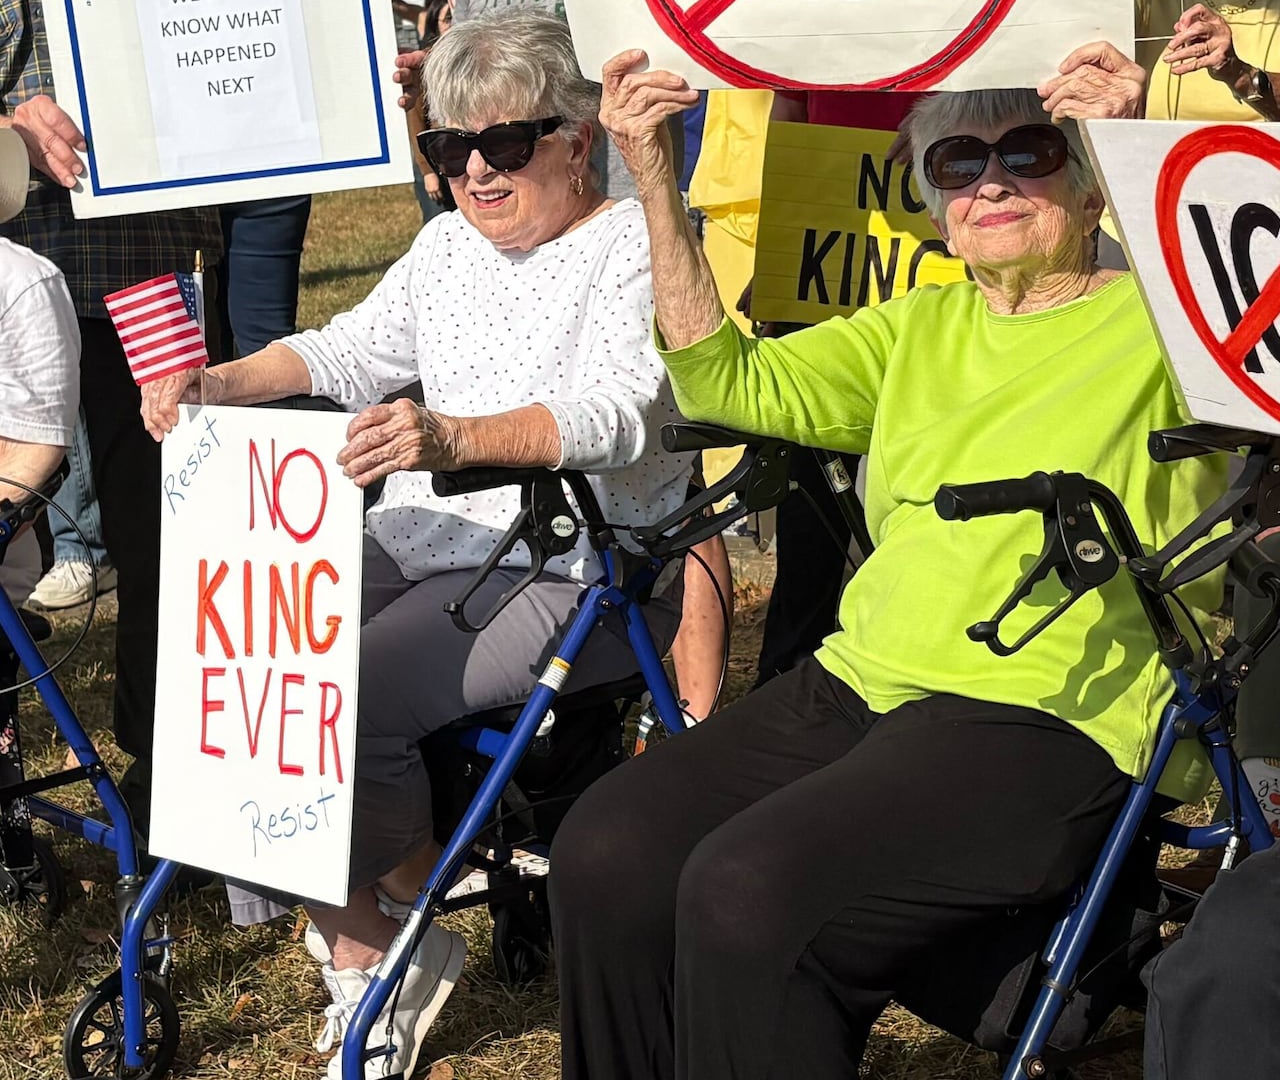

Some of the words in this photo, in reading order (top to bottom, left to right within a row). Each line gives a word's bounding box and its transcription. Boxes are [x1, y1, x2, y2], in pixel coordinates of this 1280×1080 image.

[161, 16, 220, 38] KNOW
[225, 8, 283, 29] WHAT
[176, 41, 277, 69] HAPPENED
[207, 75, 255, 97] NEXT
[164, 415, 223, 515] Resist
[249, 437, 328, 544] NO
[196, 558, 343, 660] KING
[200, 667, 345, 784] EVER
[240, 787, 336, 858] Resist
